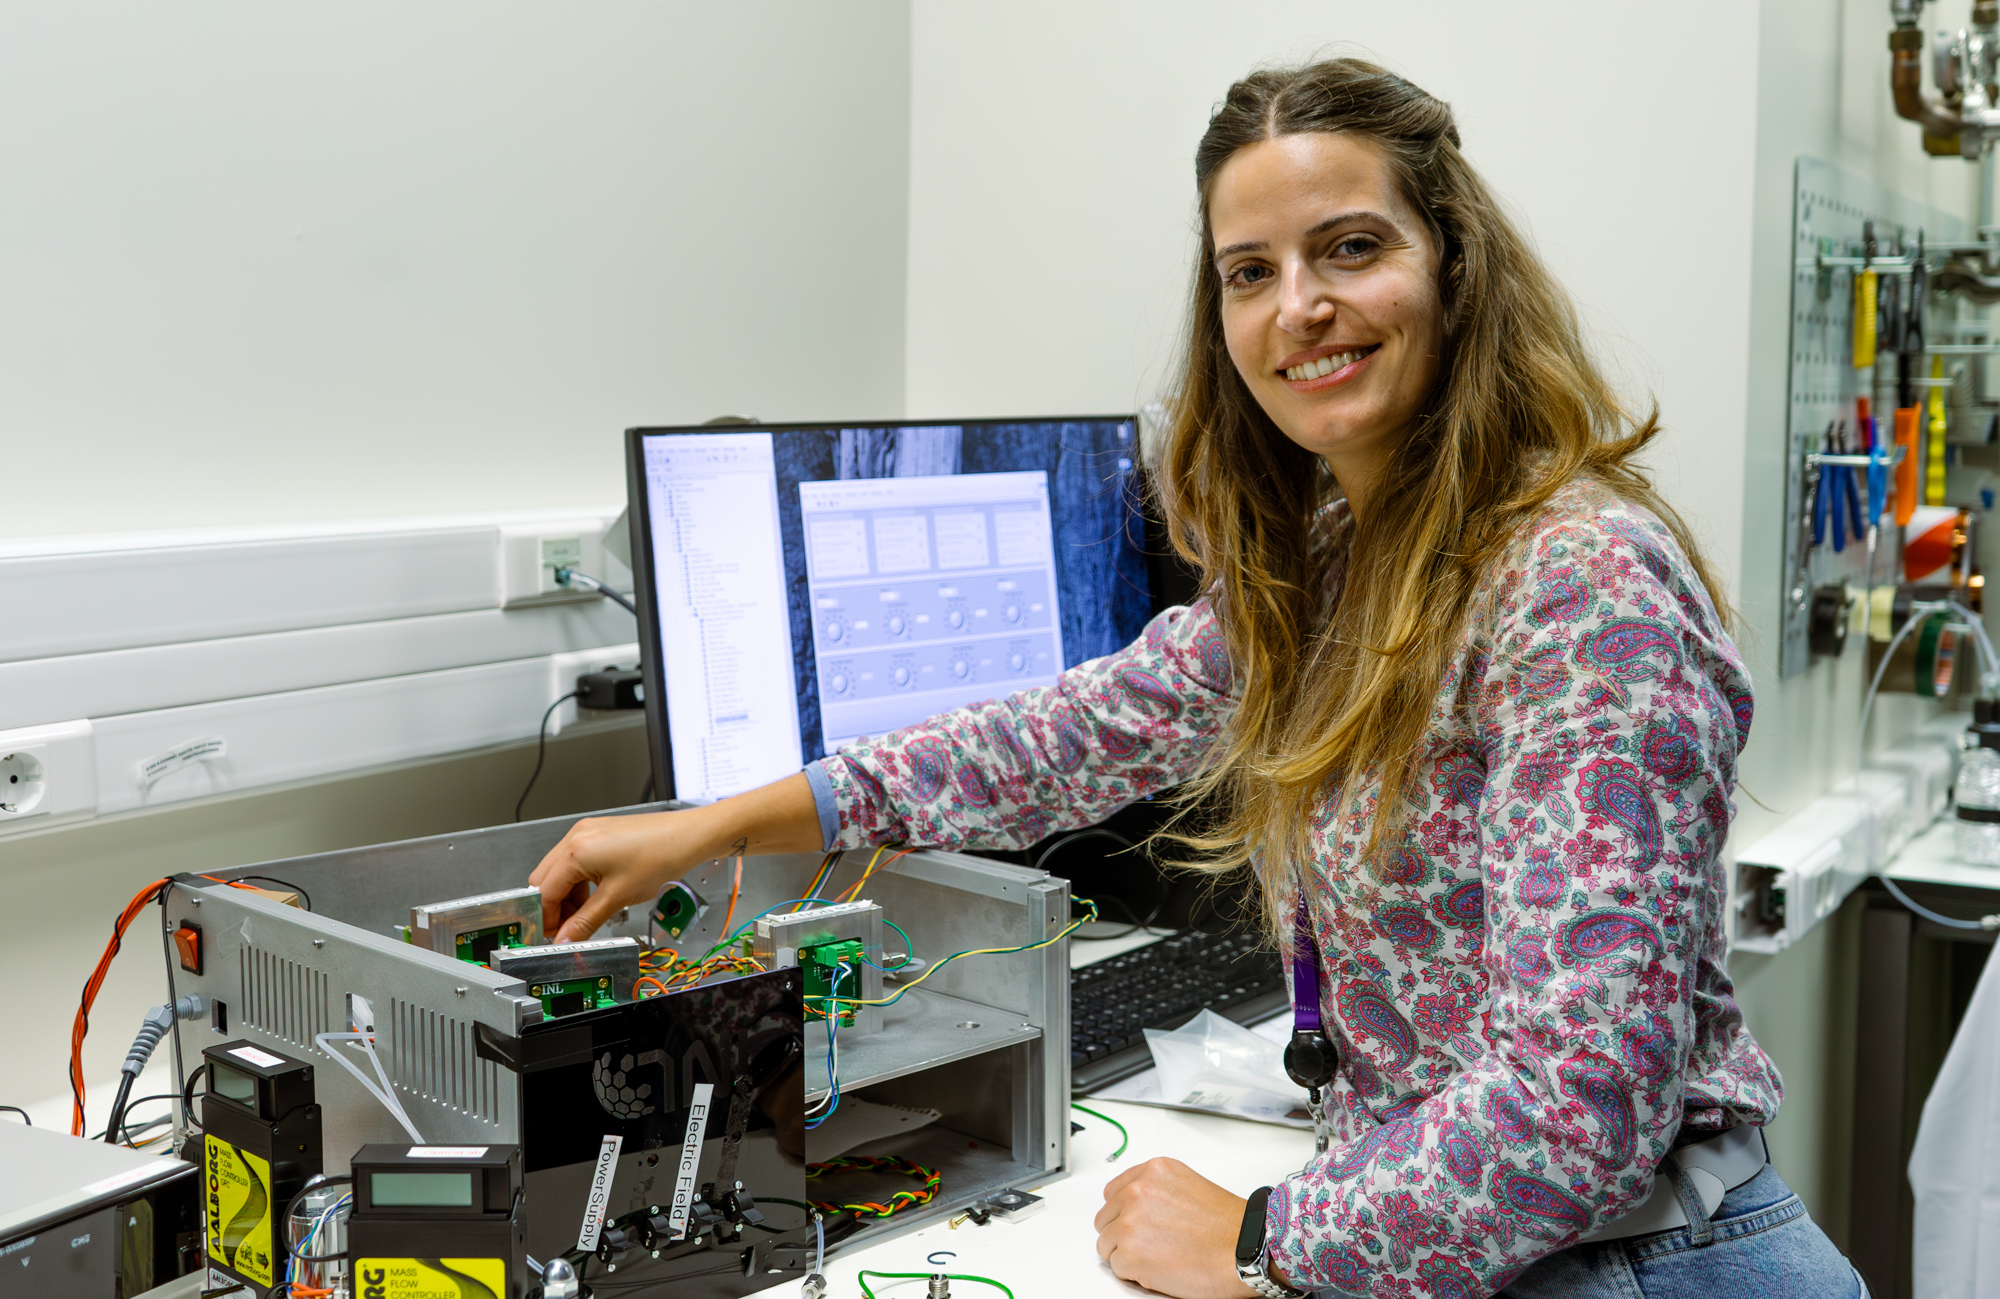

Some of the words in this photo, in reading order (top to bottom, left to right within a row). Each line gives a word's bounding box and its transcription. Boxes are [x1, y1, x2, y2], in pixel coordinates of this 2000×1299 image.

[541, 983, 564, 995] INL
[682, 1104, 706, 1171] Electric
[219, 1147, 232, 1160] MASS
[220, 1158, 232, 1169] FLOW
[220, 1168, 249, 1187] CONTROLLER
[208, 1143, 221, 1254] AALBORG
[580, 1141, 617, 1248] PowerSupply
[672, 1176, 692, 1220] Field
[390, 1268, 418, 1277] MASS
[390, 1279, 419, 1289] FLOW
[390, 1291, 456, 1299] CONTROLLER
